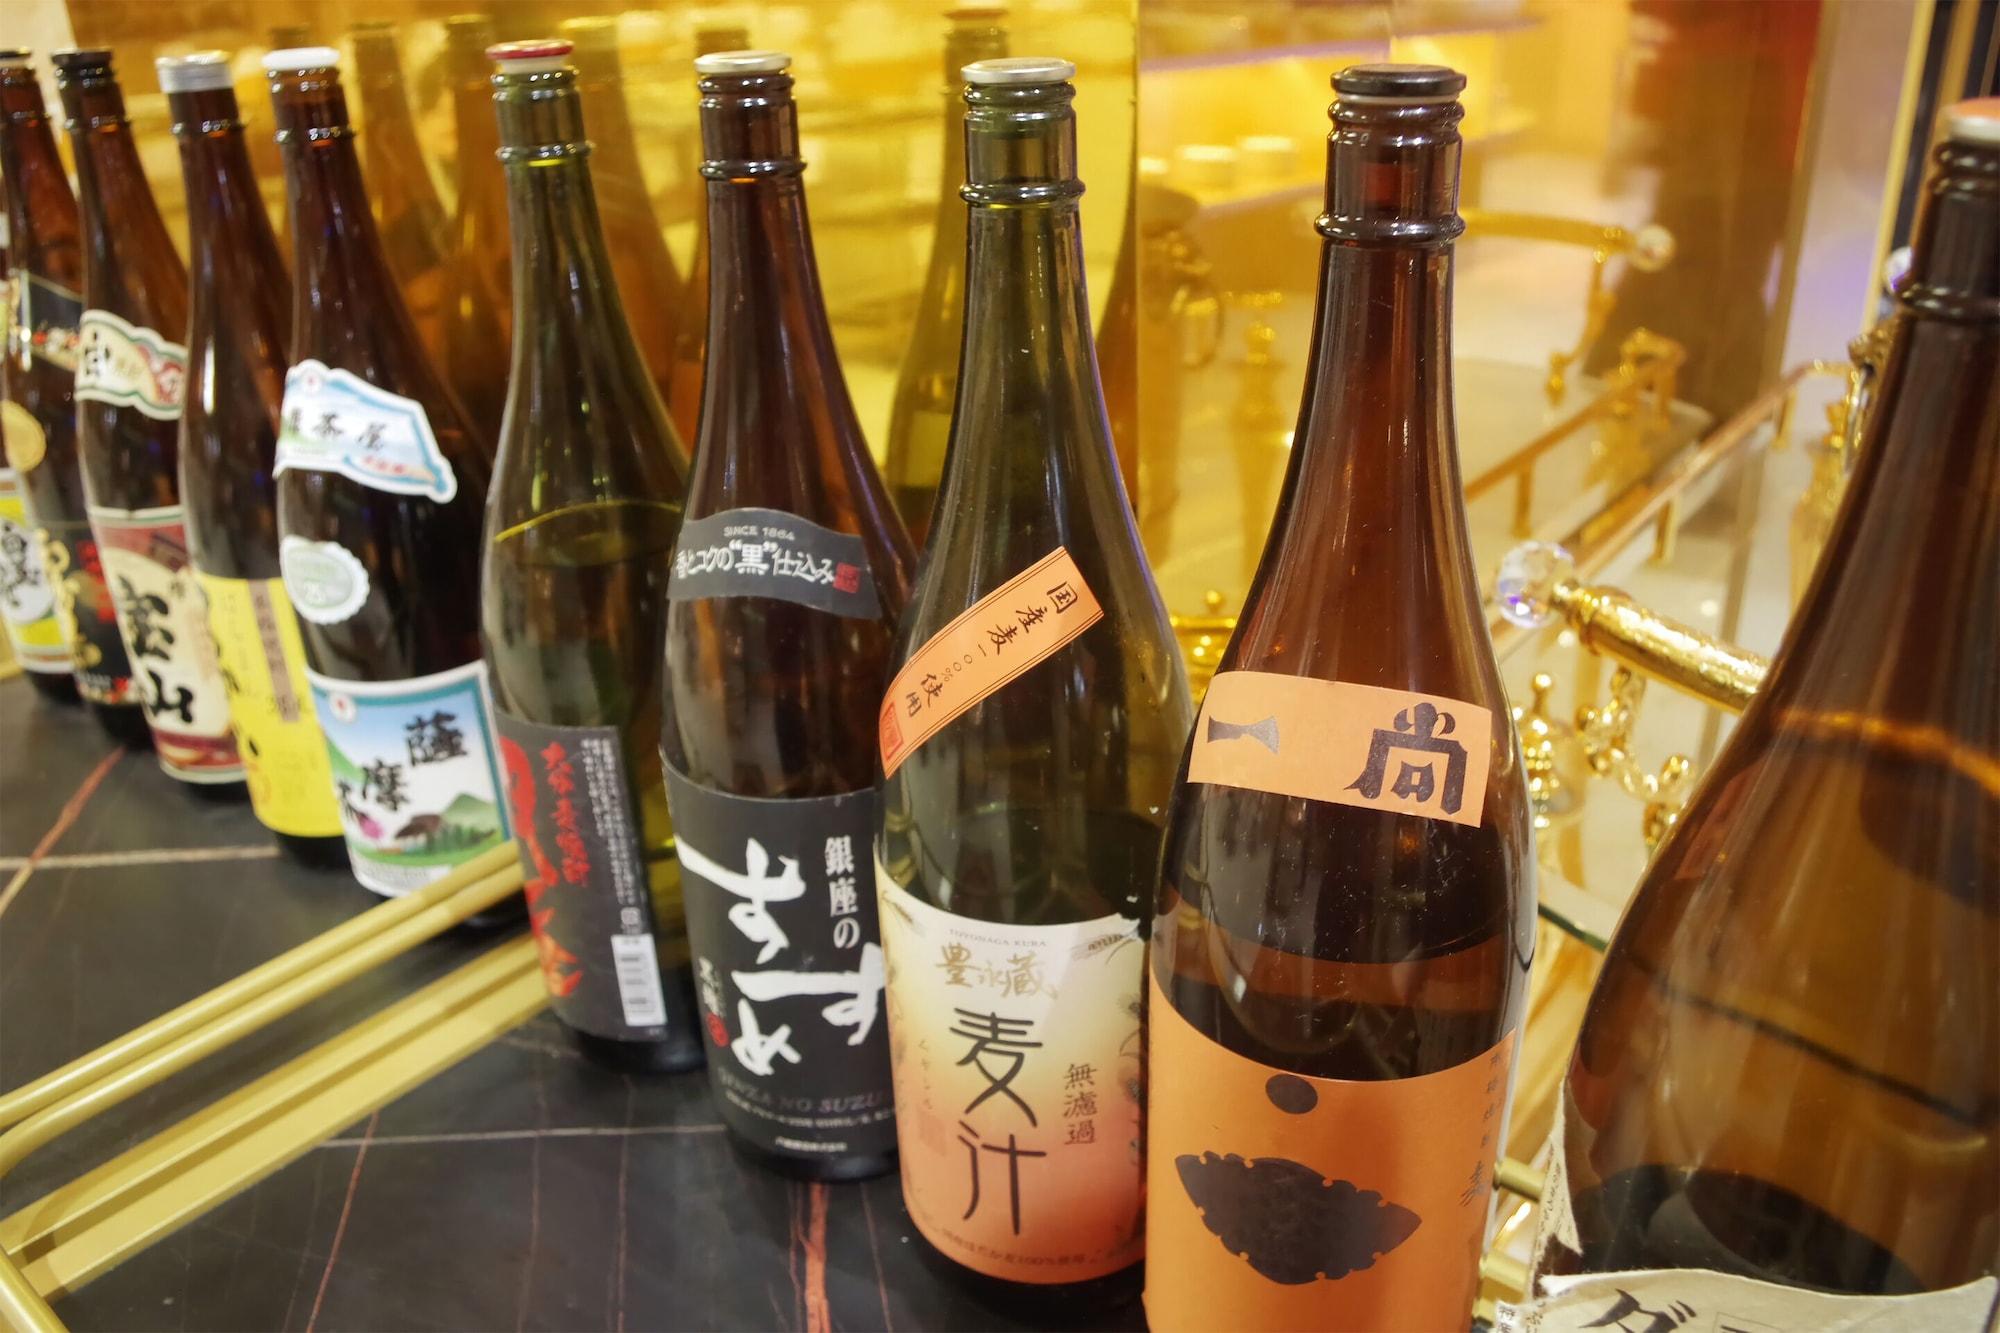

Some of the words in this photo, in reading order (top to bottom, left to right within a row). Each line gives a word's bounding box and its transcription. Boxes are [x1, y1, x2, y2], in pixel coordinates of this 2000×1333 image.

[724, 525, 758, 537] SINCE
[825, 835, 862, 950] 銀座の
[949, 1007, 1047, 1236] 麦汁
[1063, 1063, 1098, 1146] 無濾過
